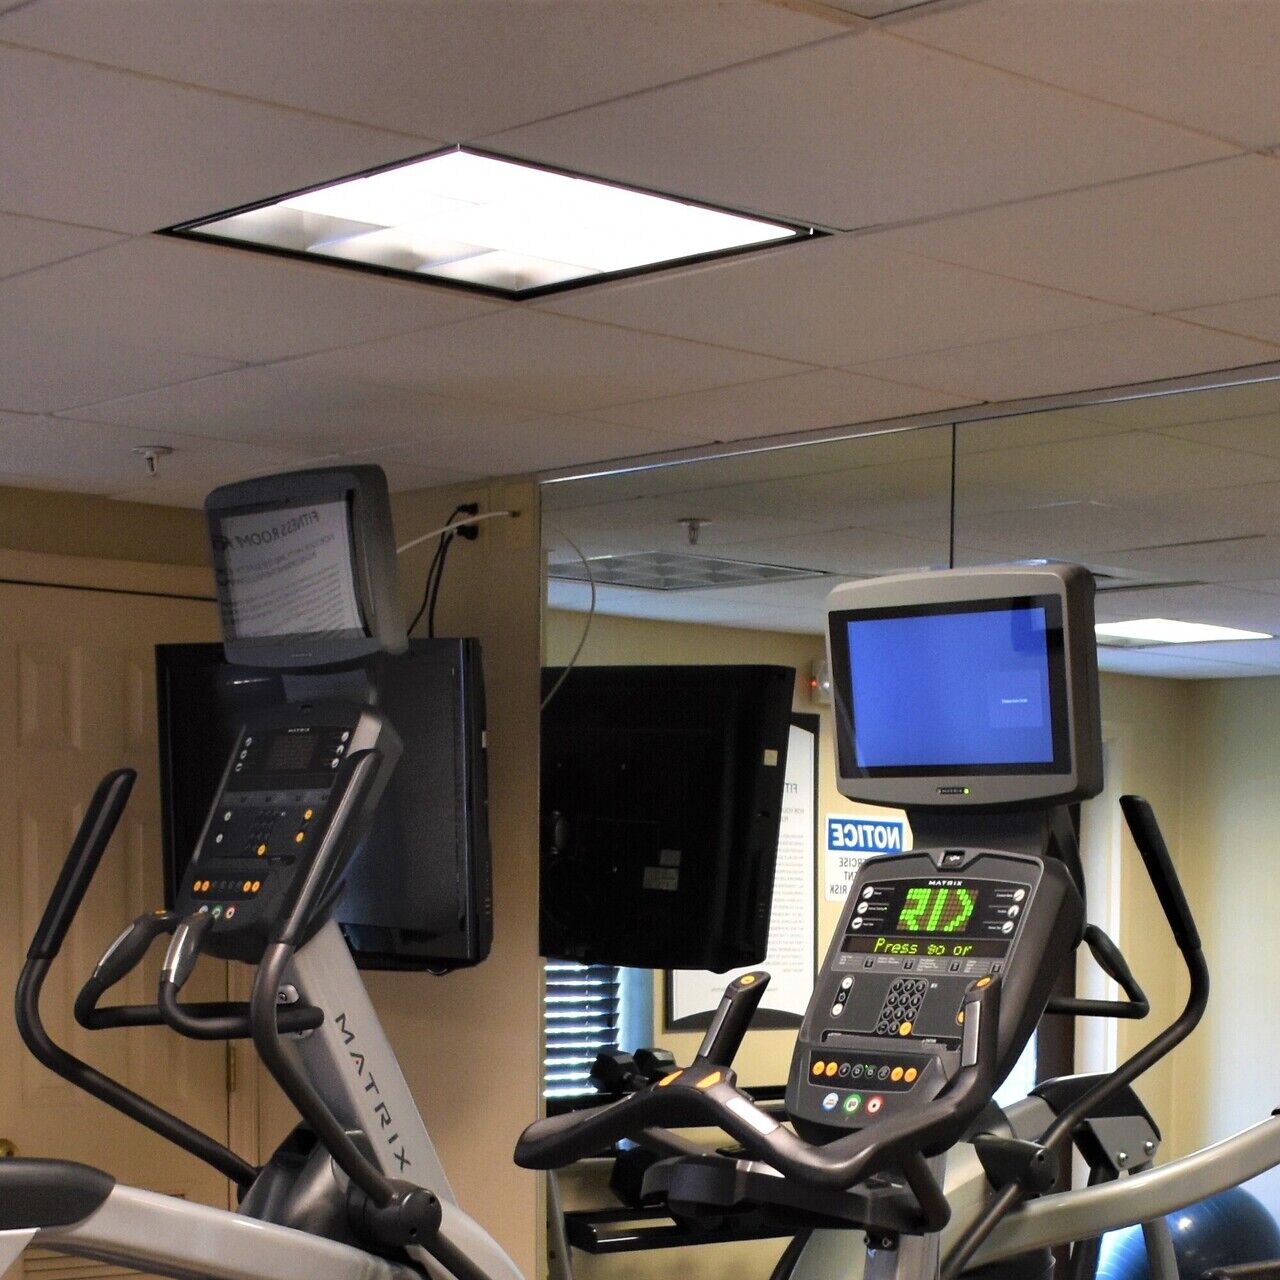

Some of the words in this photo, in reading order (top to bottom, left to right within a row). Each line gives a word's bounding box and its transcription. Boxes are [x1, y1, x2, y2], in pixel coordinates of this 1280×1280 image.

[874, 937, 918, 954] Press
[953, 945, 973, 956] or
[335, 1011, 413, 1173] MATRIX
